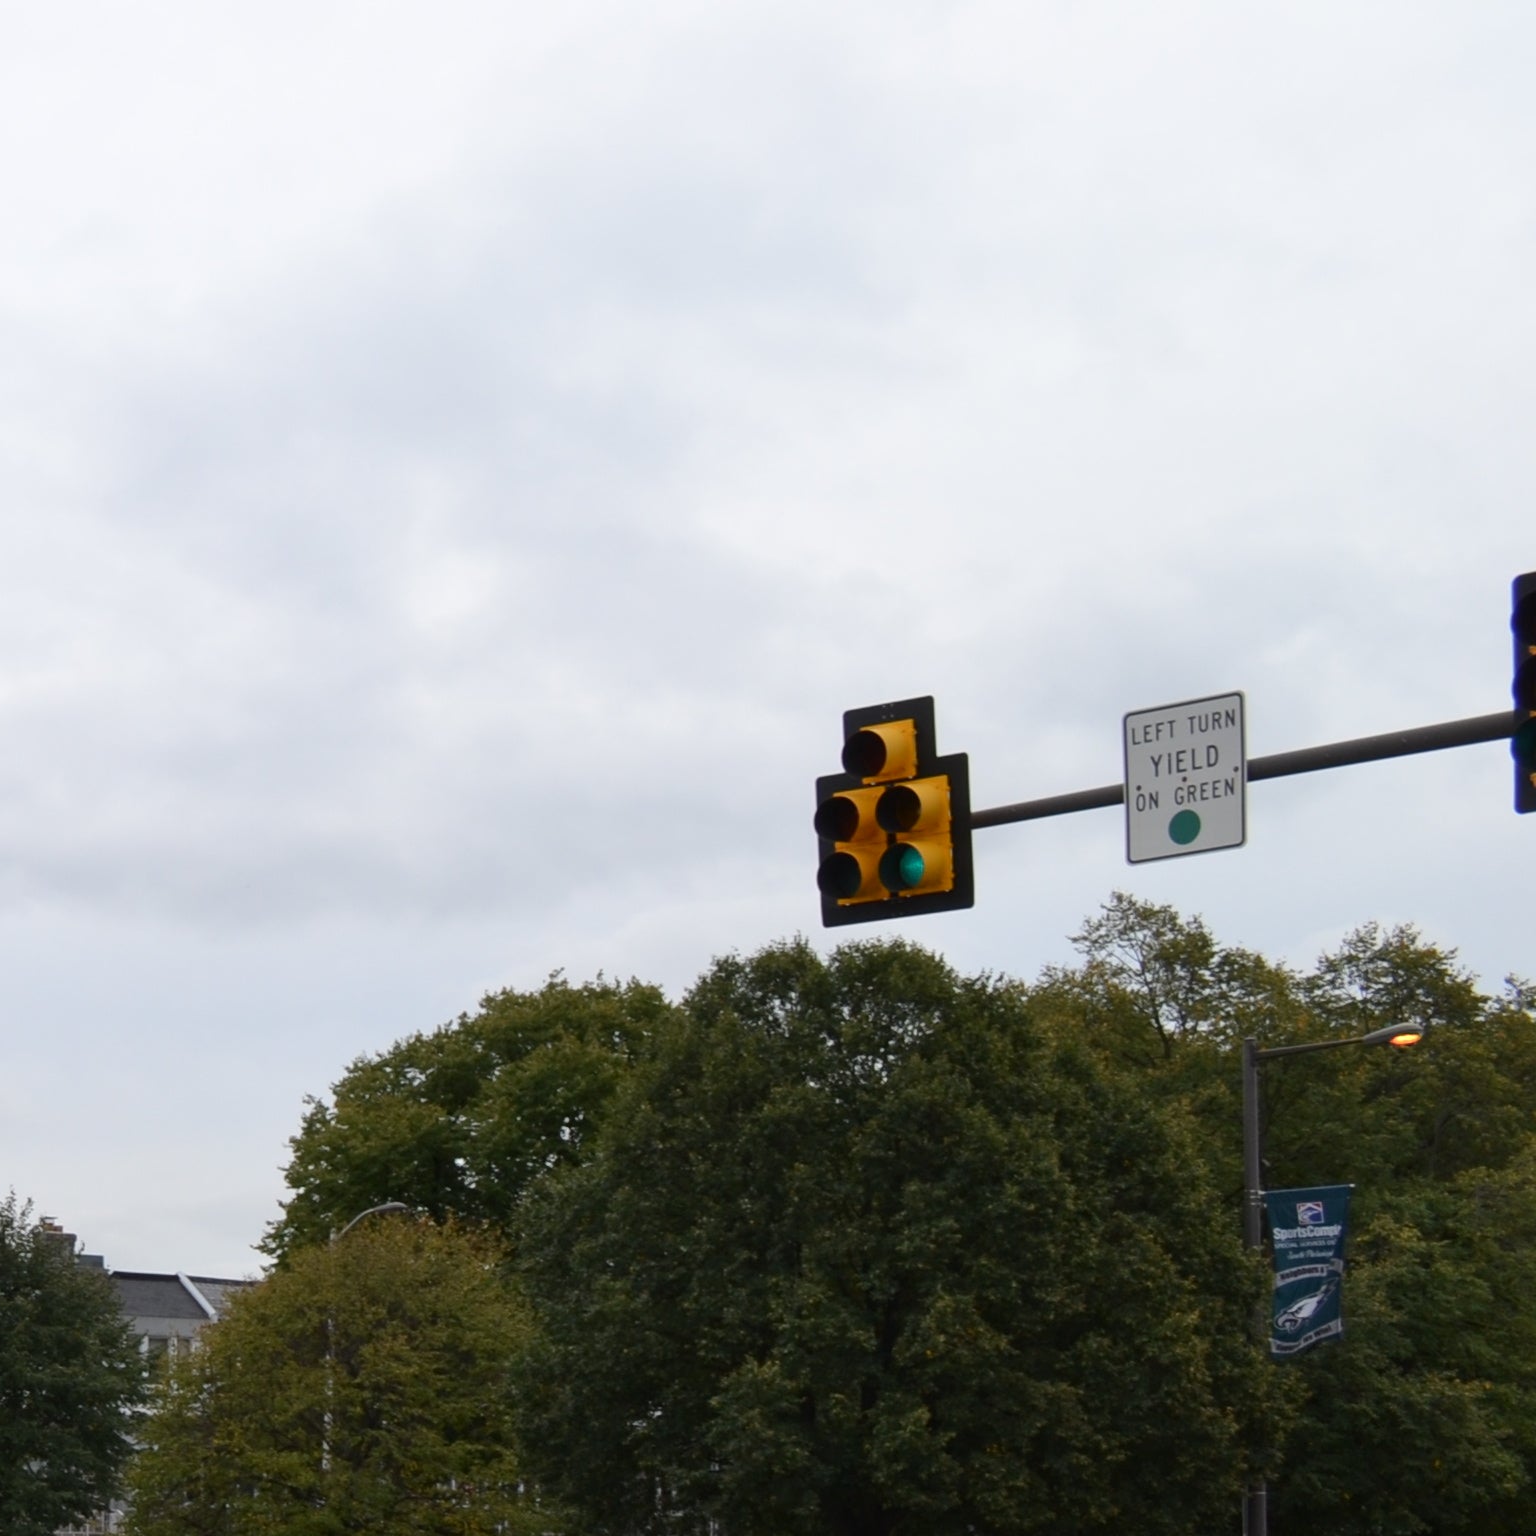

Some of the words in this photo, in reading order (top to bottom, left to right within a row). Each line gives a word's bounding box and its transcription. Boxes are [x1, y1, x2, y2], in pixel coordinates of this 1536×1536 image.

[1131, 719, 1177, 746] LEFT
[1187, 708, 1236, 735] TURN
[1150, 744, 1219, 778] YIELD
[1135, 791, 1159, 812] ON
[1174, 777, 1235, 806] GREEN
